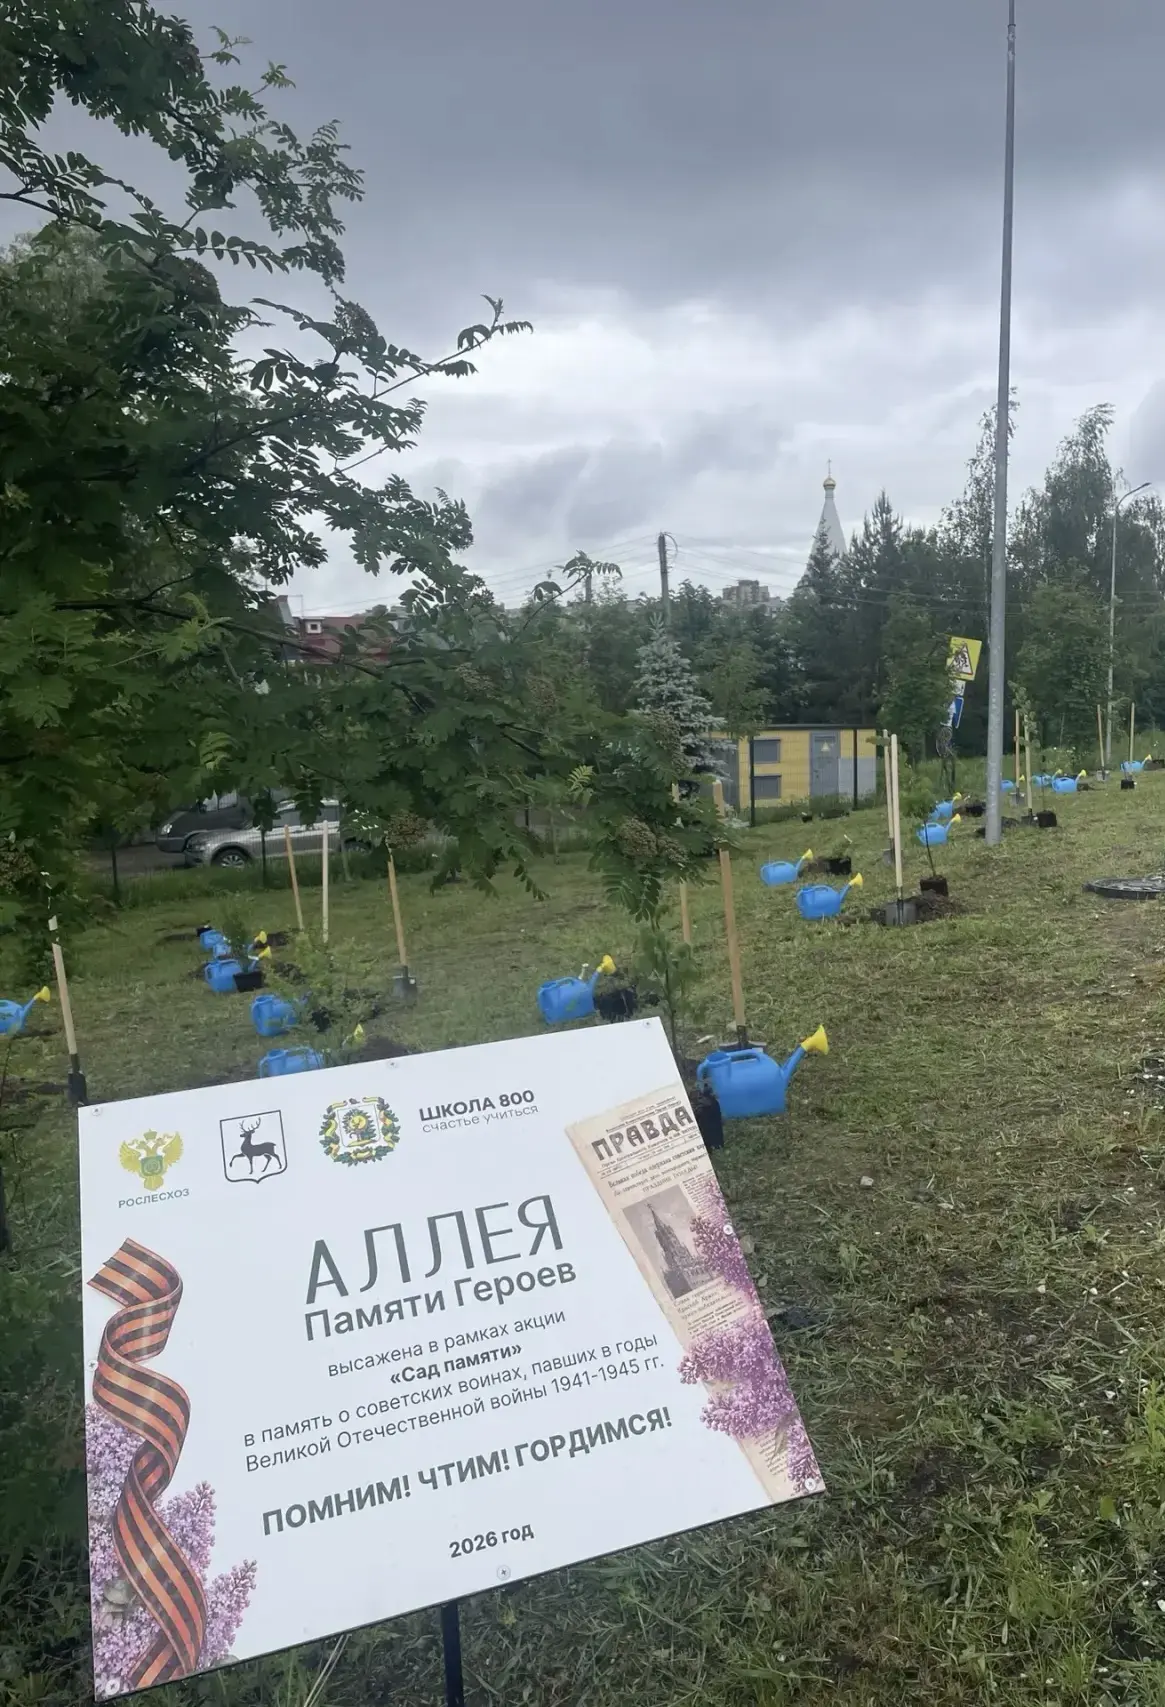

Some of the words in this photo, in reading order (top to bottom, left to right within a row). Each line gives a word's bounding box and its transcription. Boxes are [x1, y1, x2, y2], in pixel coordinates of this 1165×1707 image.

[419, 1097, 496, 1121] ШКОЛА
[499, 1090, 534, 1107] 800
[423, 1116, 479, 1133] счастье
[483, 1106, 538, 1124] учиться
[592, 1106, 694, 1161] ПРАВДА
[119, 1188, 189, 1208] РОСЛЕСХОЗ
[306, 1195, 563, 1305] АЛЛЕЯ
[305, 1290, 445, 1341] Памяти
[454, 1263, 576, 1306] Героев
[328, 1344, 423, 1377] высажена
[429, 1341, 439, 1353] в
[444, 1324, 509, 1353] рамках
[514, 1311, 565, 1332] акции
[390, 1364, 440, 1384] «Сад
[444, 1345, 522, 1373] памяти»
[244, 1434, 255, 1447] в
[262, 1416, 332, 1442] память
[339, 1410, 350, 1423] о
[356, 1384, 453, 1418] советских
[458, 1367, 527, 1393] воинах,
[532, 1349, 597, 1375] павших
[601, 1346, 611, 1358] в
[616, 1334, 657, 1354] годы
[246, 1436, 331, 1472] Великой
[337, 1400, 485, 1448] Отечественной
[490, 1385, 547, 1409] войны
[551, 1358, 639, 1393] 1941-1945
[644, 1356, 664, 1370] гг.
[263, 1475, 411, 1536] ПОМНИМ!
[418, 1448, 510, 1490] ЧТИМ!
[514, 1407, 672, 1467] ГОРДИМСЯ!
[449, 1531, 498, 1558] 2026
[501, 1524, 534, 1544] год
